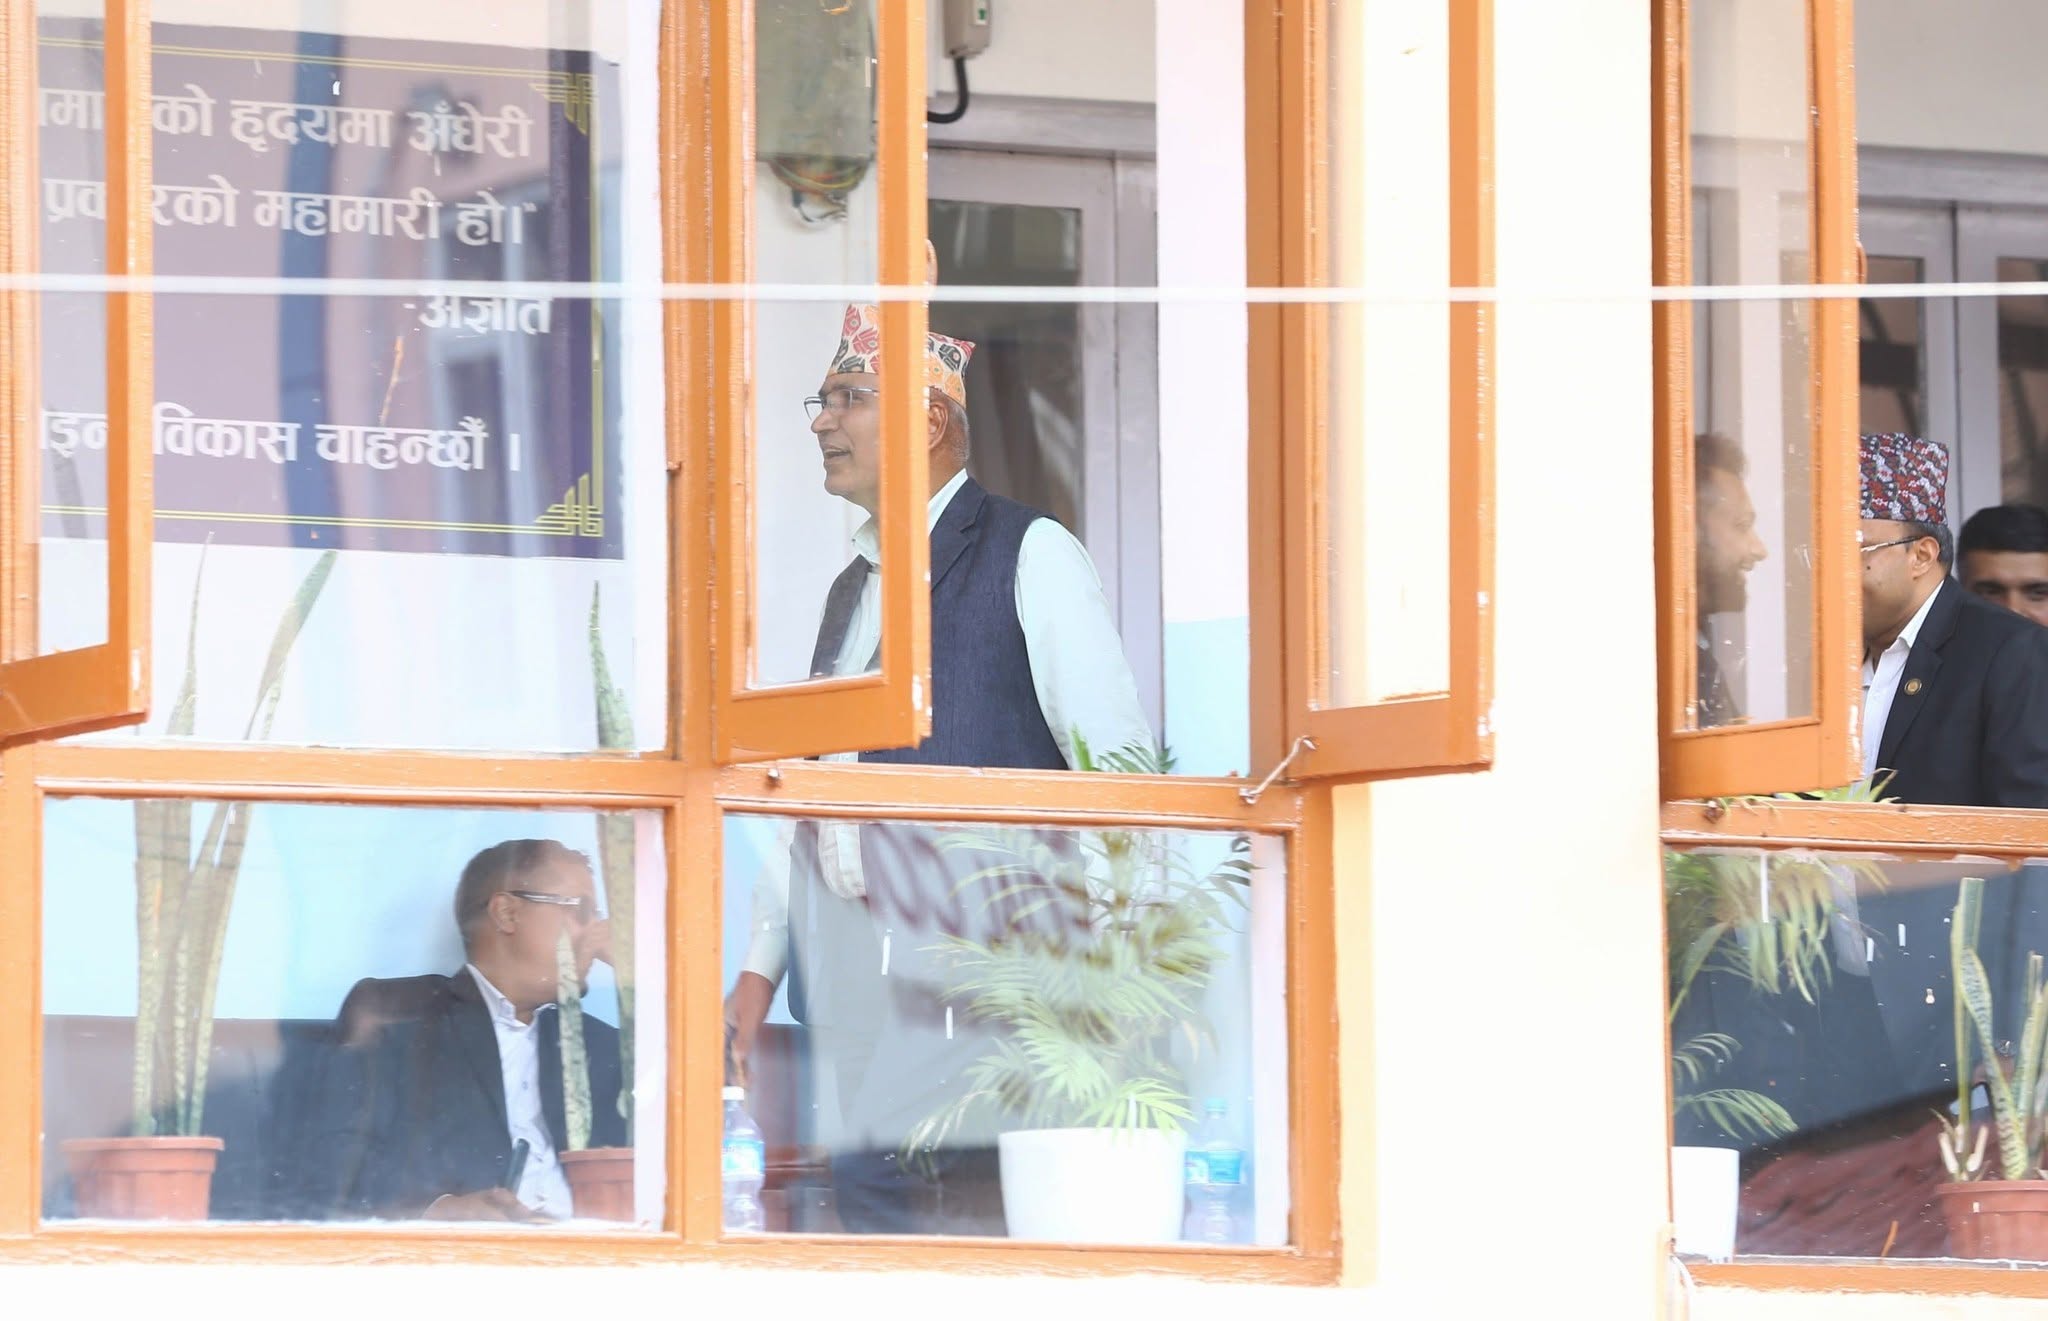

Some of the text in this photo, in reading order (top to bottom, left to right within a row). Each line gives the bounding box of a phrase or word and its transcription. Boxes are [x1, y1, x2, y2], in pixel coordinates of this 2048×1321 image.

[230, 100, 393, 152] हृदयमा
[253, 187, 443, 240] महामारी
[152, 402, 302, 464] विकास
